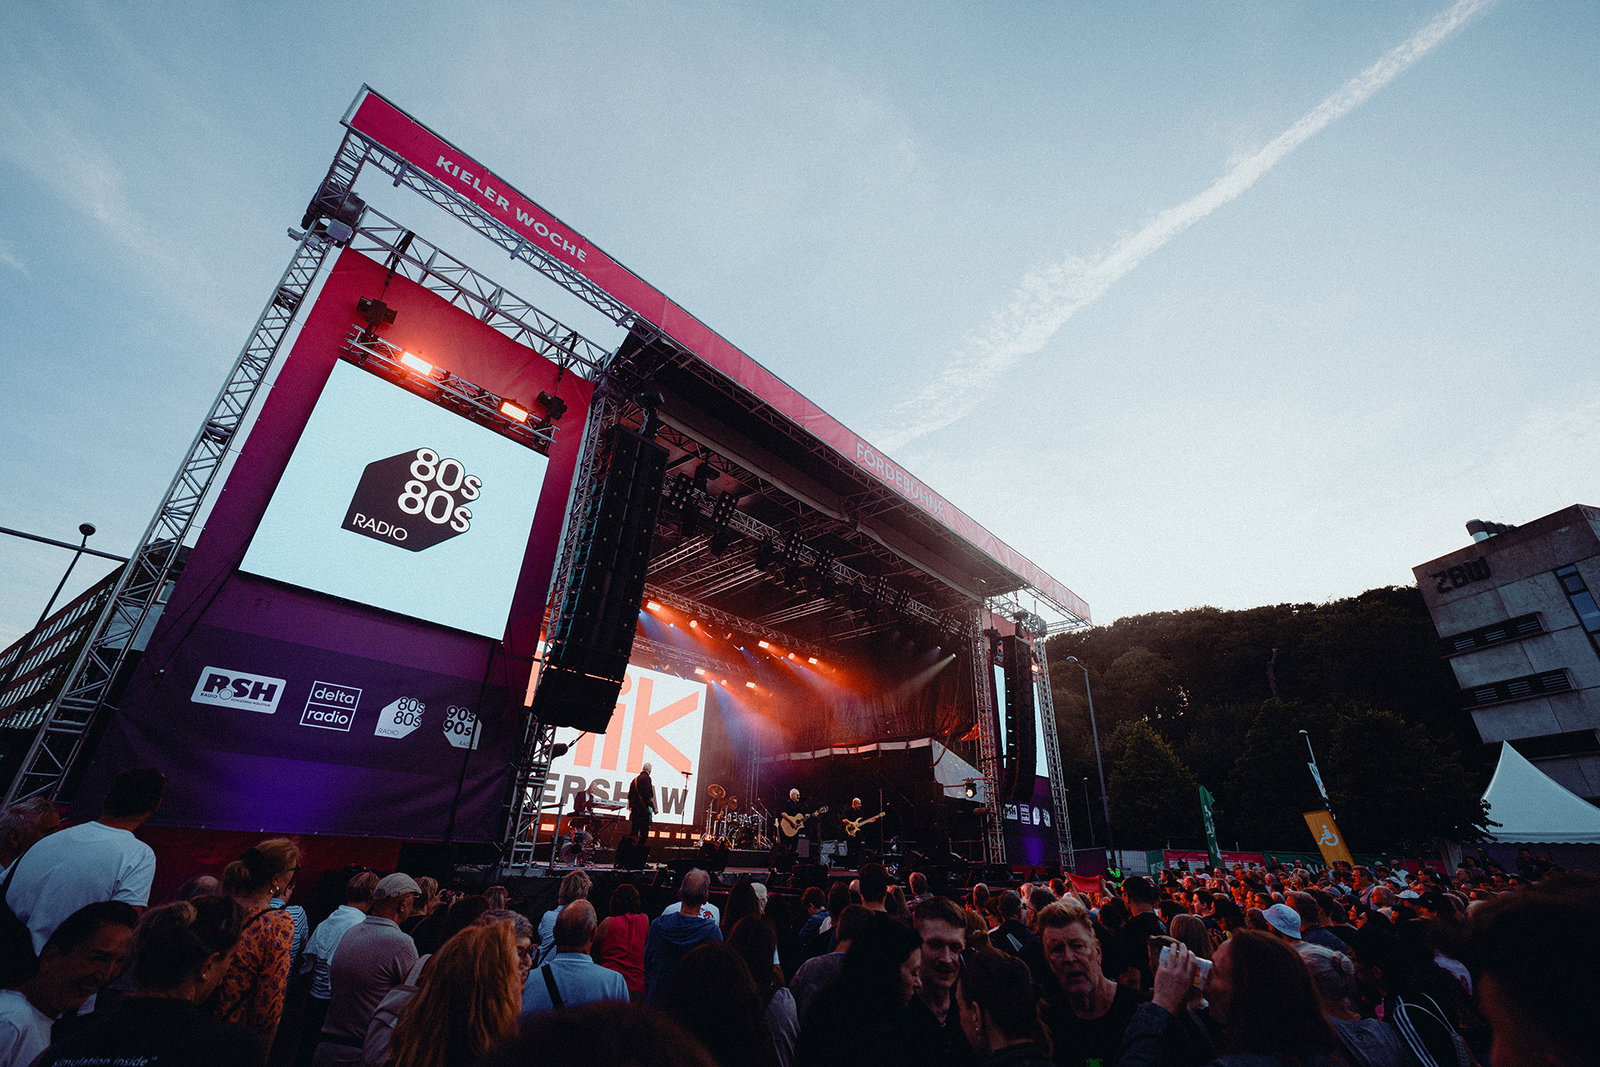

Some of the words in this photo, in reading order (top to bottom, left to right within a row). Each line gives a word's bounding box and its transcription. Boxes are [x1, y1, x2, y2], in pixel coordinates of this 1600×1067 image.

[435, 154, 510, 212] KIELER
[515, 206, 588, 264] WOCHE
[409, 447, 482, 501] 80s
[855, 441, 945, 518] FÖRDEBÜHNE
[397, 479, 473, 533] 80s
[352, 512, 408, 541] RADIO
[1429, 555, 1492, 594] ZBW
[202, 673, 279, 703] RSH
[314, 687, 356, 705] delta
[397, 696, 426, 714] 80s
[446, 705, 475, 723] 90s
[306, 710, 349, 725] radio
[393, 710, 422, 728] 80s
[443, 719, 472, 737] 90s
[377, 727, 400, 736] RADIO
